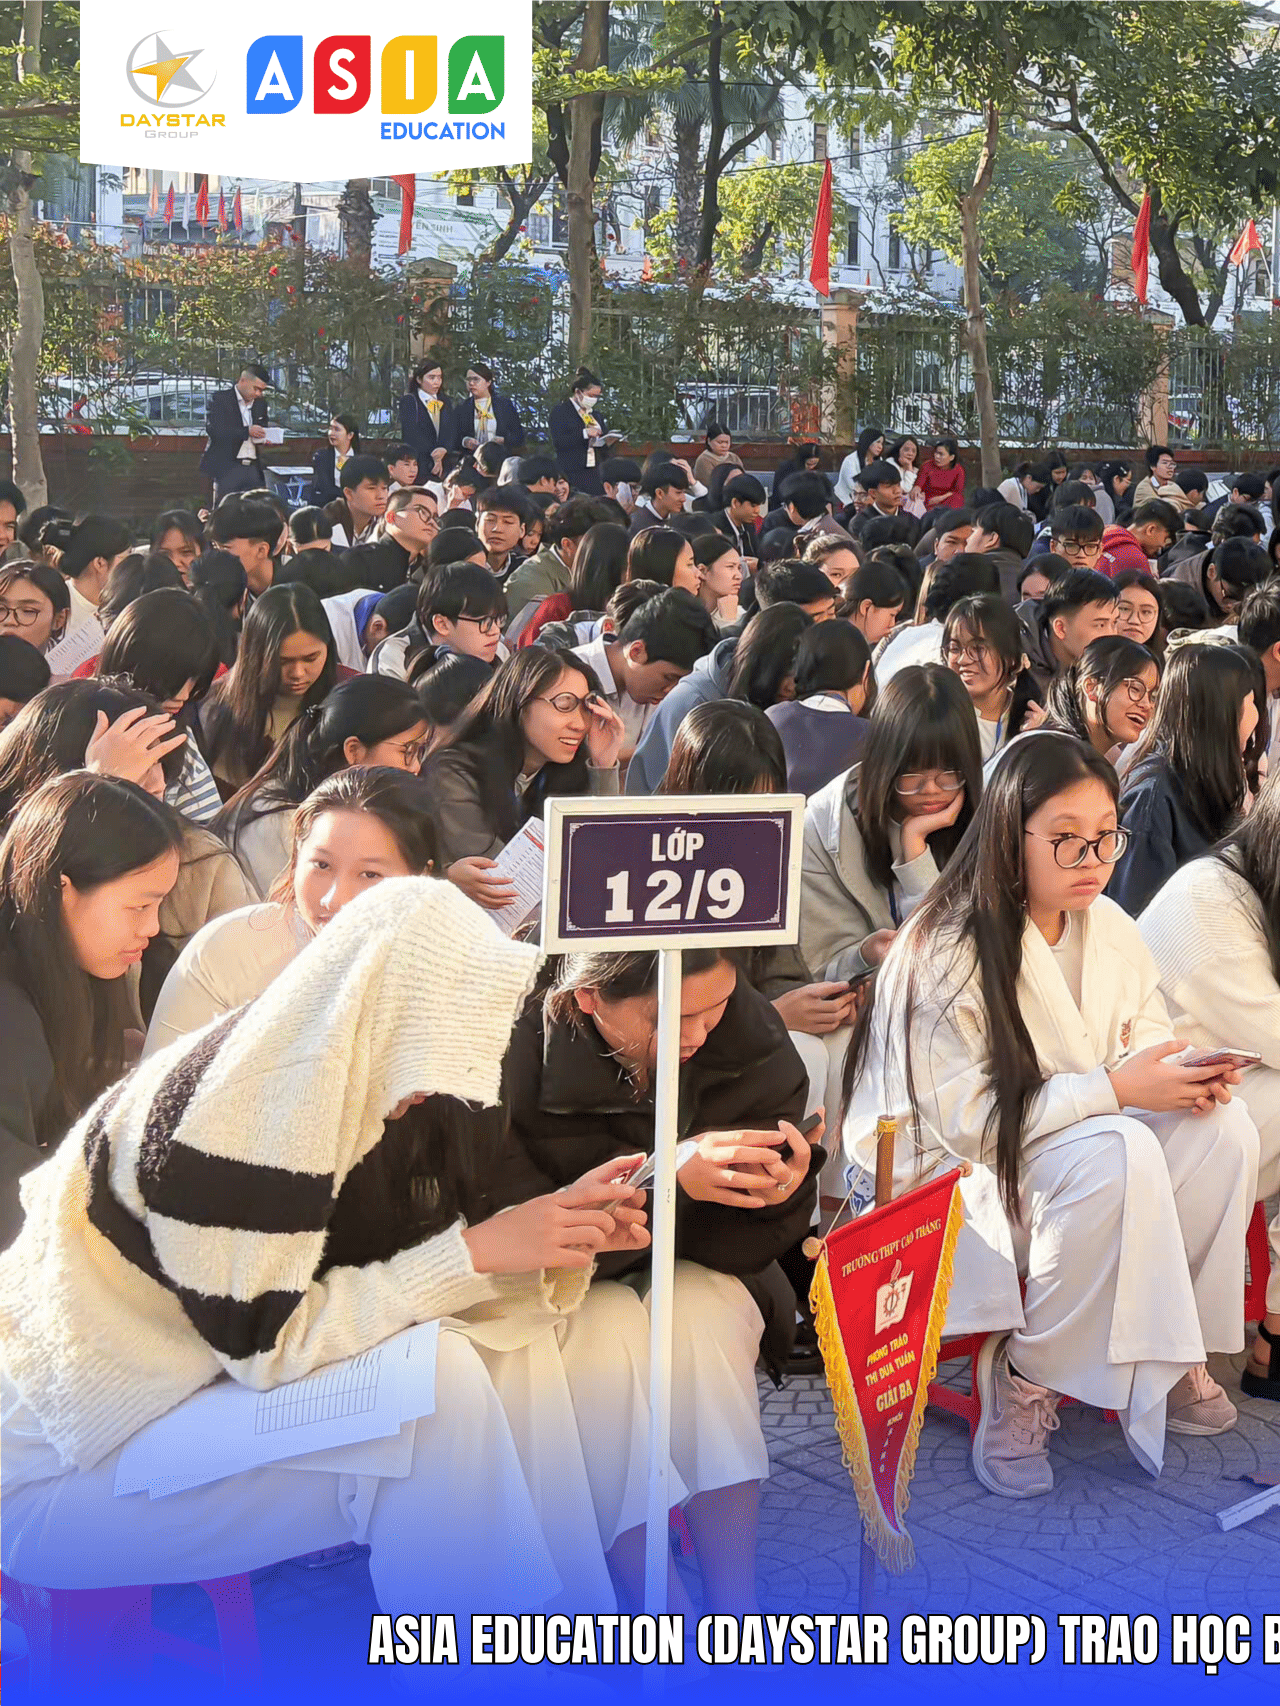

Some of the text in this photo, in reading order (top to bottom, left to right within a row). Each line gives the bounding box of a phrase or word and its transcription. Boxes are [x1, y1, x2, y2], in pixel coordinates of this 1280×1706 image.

[651, 827, 705, 862] LỚP
[605, 868, 745, 923] 12/9
[878, 1239, 901, 1260] THPT
[898, 1379, 913, 1400] BA
